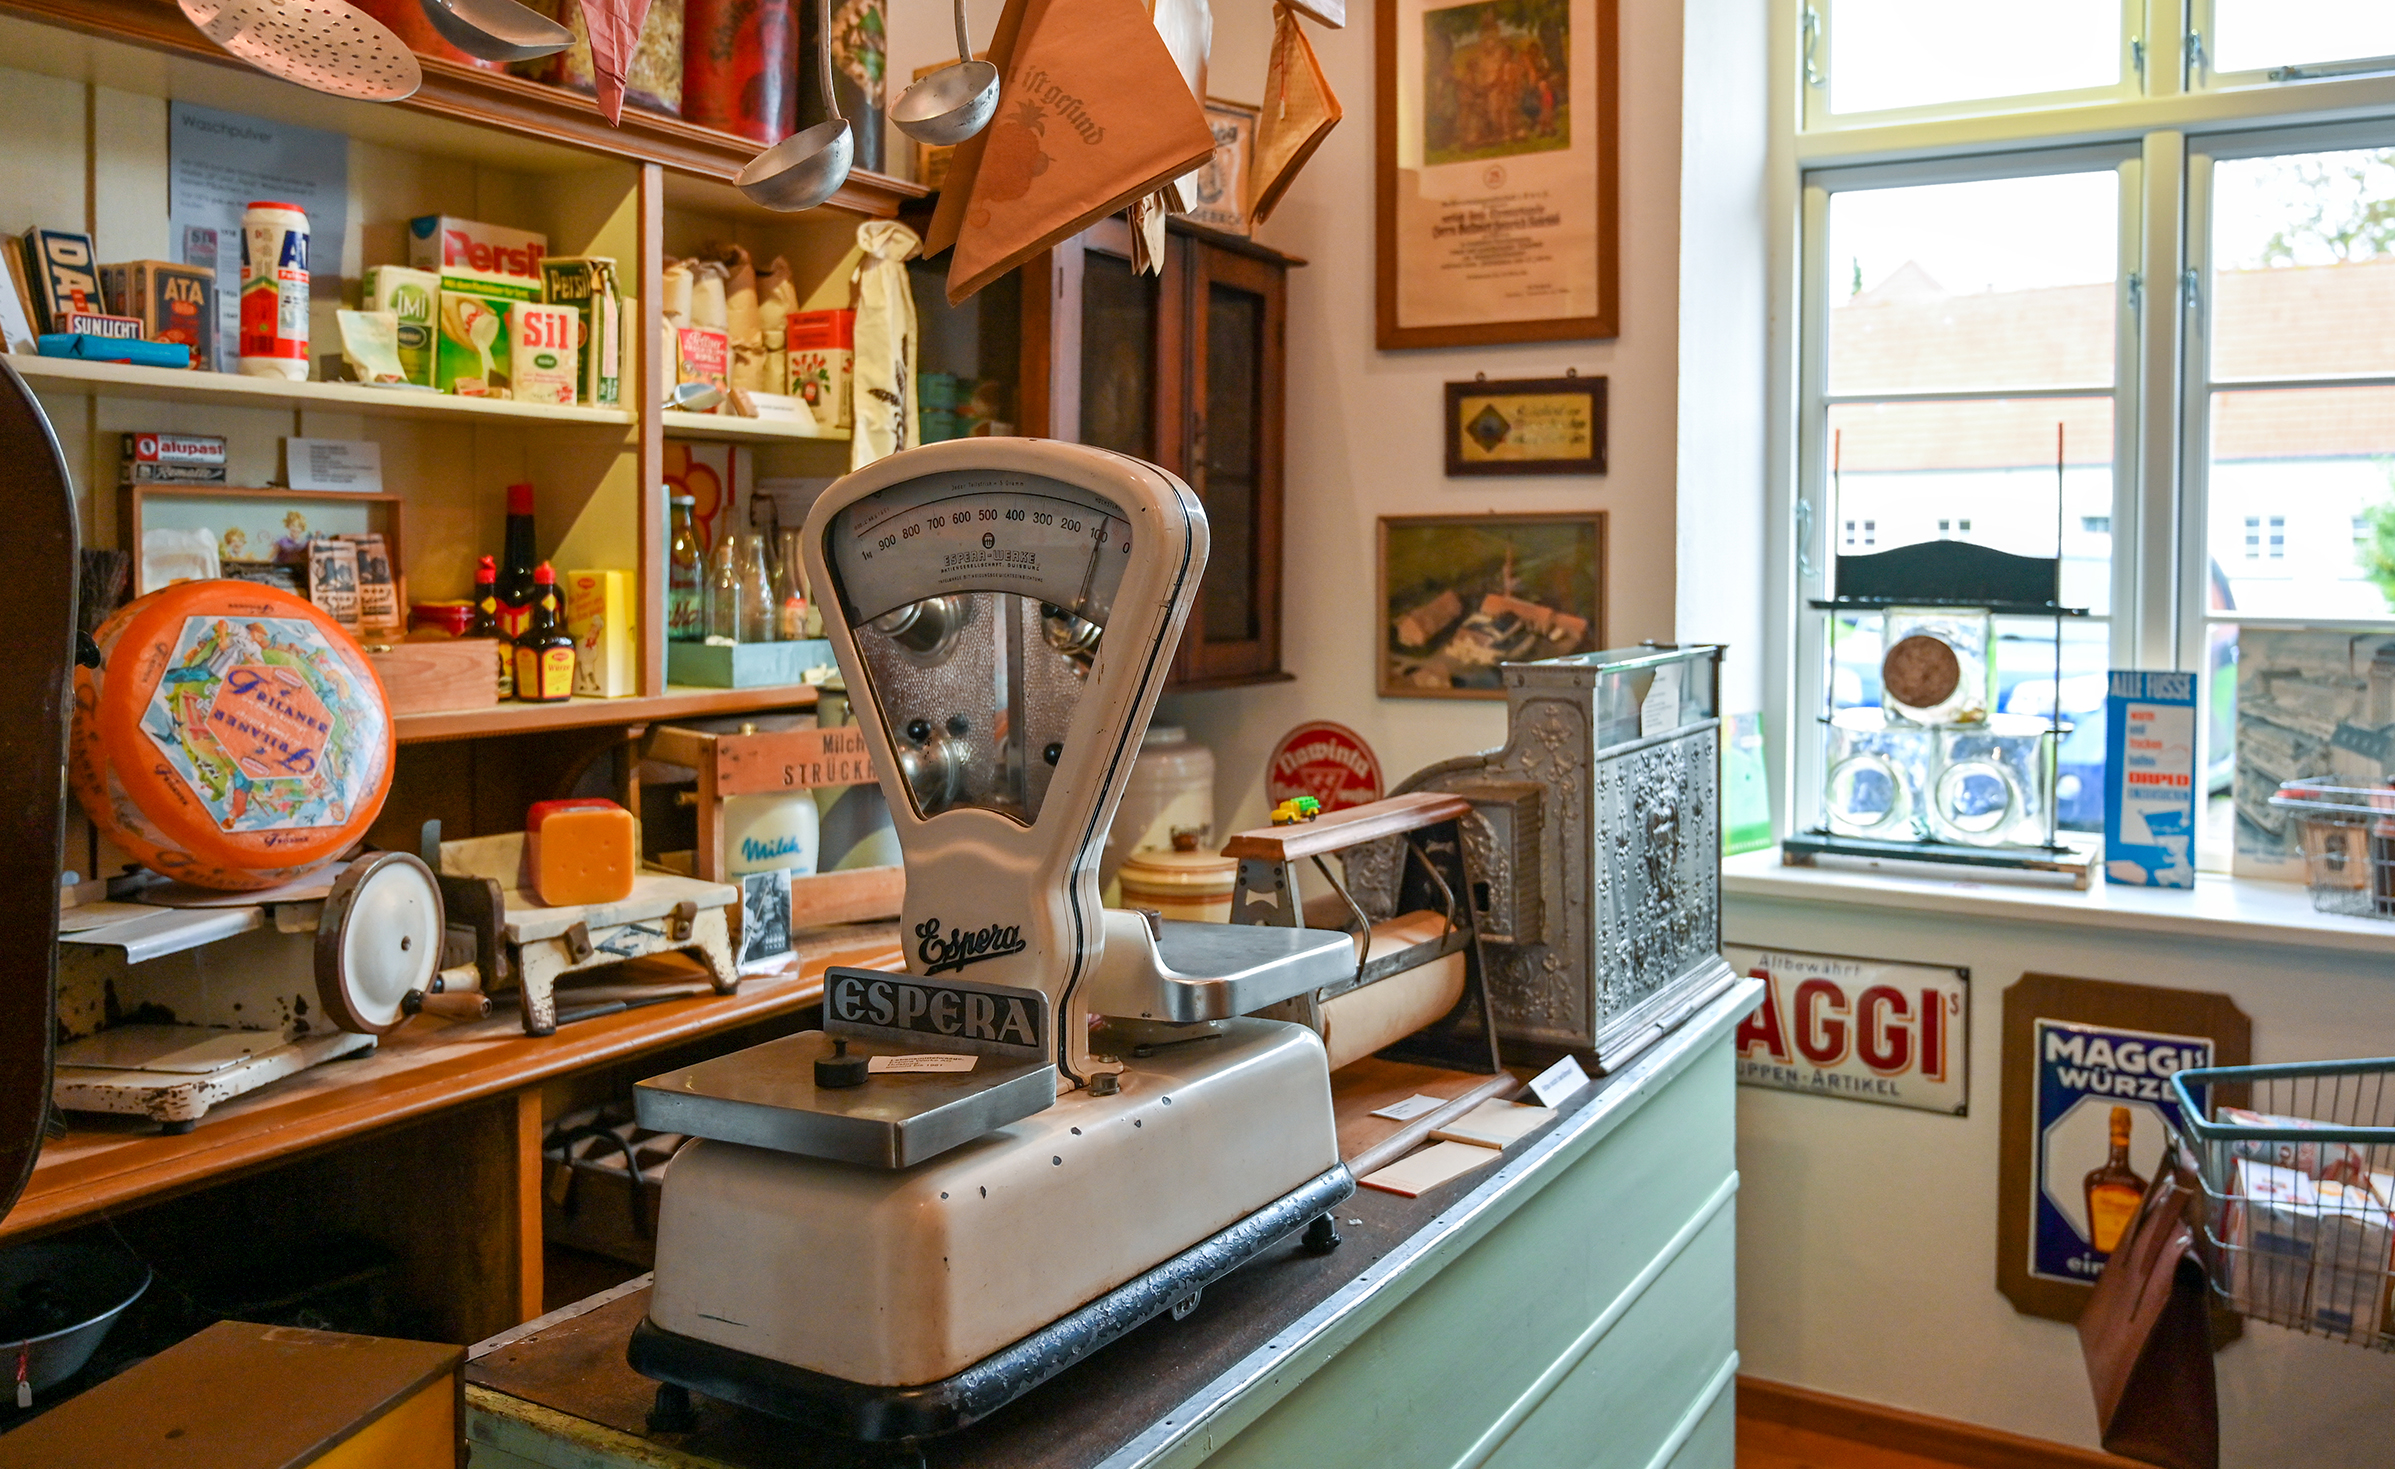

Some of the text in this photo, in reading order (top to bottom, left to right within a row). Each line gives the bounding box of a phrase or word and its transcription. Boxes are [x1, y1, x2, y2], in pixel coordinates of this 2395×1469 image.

[182, 115, 272, 142] Waschpulver
[444, 229, 546, 279] Persil
[164, 276, 205, 306] ATA
[551, 268, 591, 302] Persil
[72, 316, 139, 339] SUNLICHT
[524, 311, 569, 350] Sil
[878, 534, 896, 551] 900
[902, 524, 920, 539] 800
[927, 516, 946, 531] 700
[952, 511, 971, 524] 600
[978, 509, 998, 521] 500
[1005, 509, 1025, 522] 400
[1032, 512, 1053, 525] 300
[1060, 518, 1082, 533] 200
[1090, 527, 1108, 543] 100
[1122, 541, 1131, 554] 0
[943, 549, 1036, 567] ESPERA-WERKE
[823, 732, 865, 754] Milch
[741, 835, 802, 863] Milch
[915, 918, 1026, 976] Espera
[1758, 953, 1863, 977] Altbewährt
[835, 977, 1037, 1045] ESPERA
